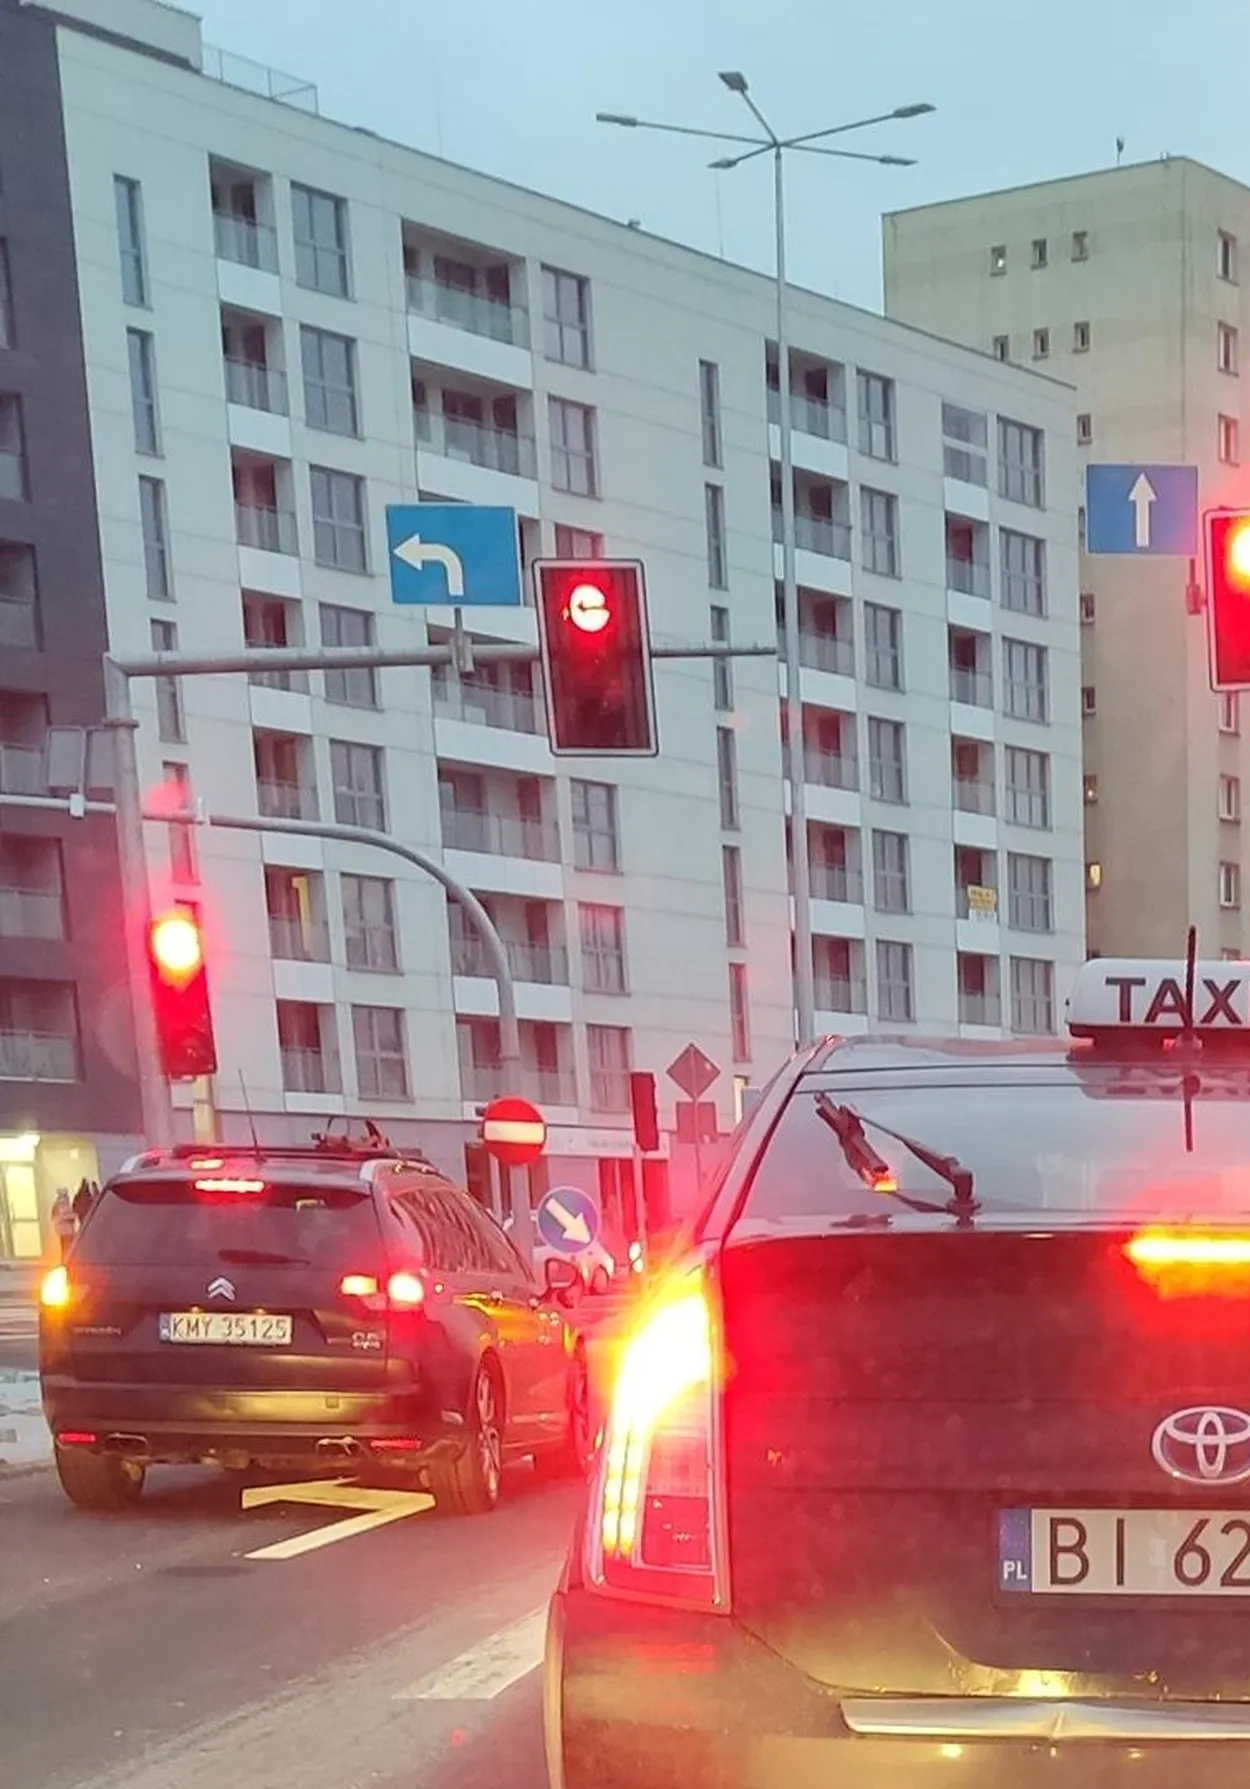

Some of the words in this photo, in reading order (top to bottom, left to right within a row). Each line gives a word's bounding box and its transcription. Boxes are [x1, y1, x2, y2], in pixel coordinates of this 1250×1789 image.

[173, 1317, 212, 1338] KMY
[222, 1316, 287, 1339] 35125
[1049, 1517, 1125, 1586] BI
[1003, 1561, 1027, 1580] PL
